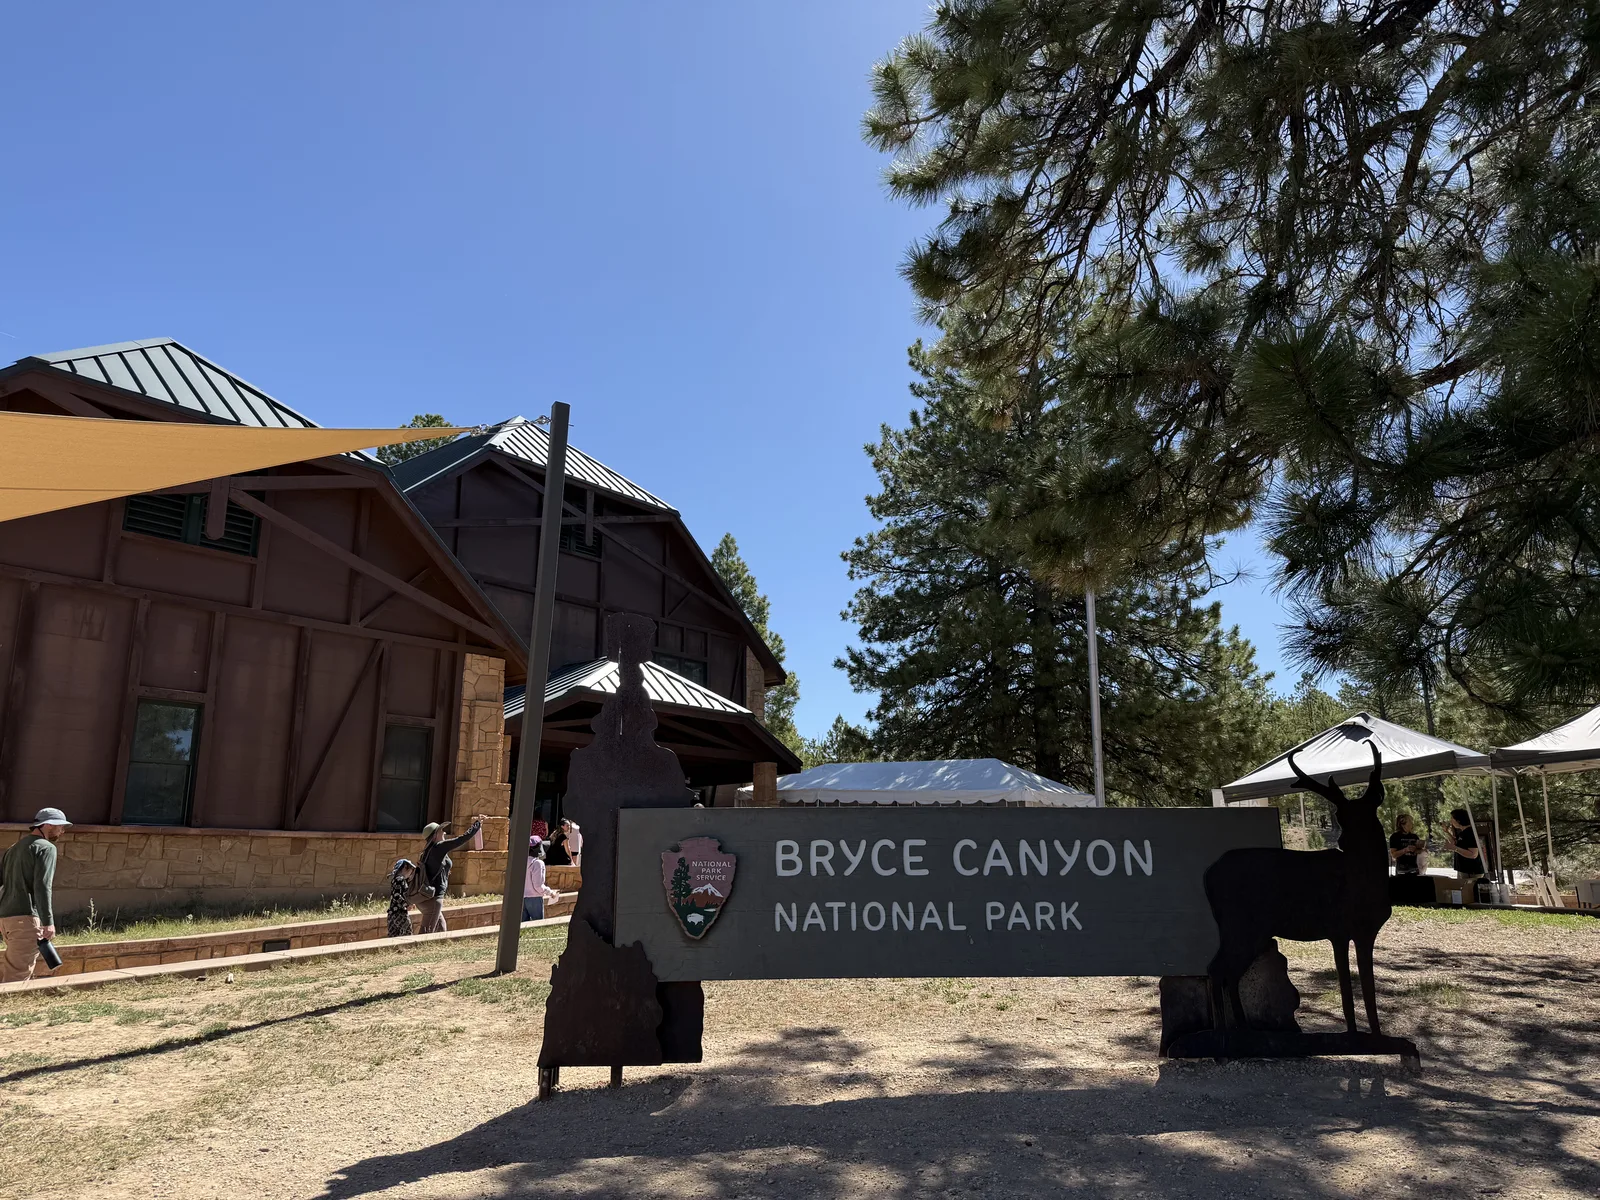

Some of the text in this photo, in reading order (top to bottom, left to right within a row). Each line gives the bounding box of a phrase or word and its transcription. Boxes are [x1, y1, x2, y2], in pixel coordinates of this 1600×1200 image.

[775, 839, 1153, 877] BRYCE CANYON
[775, 901, 1083, 932] NATIONAL PARK
